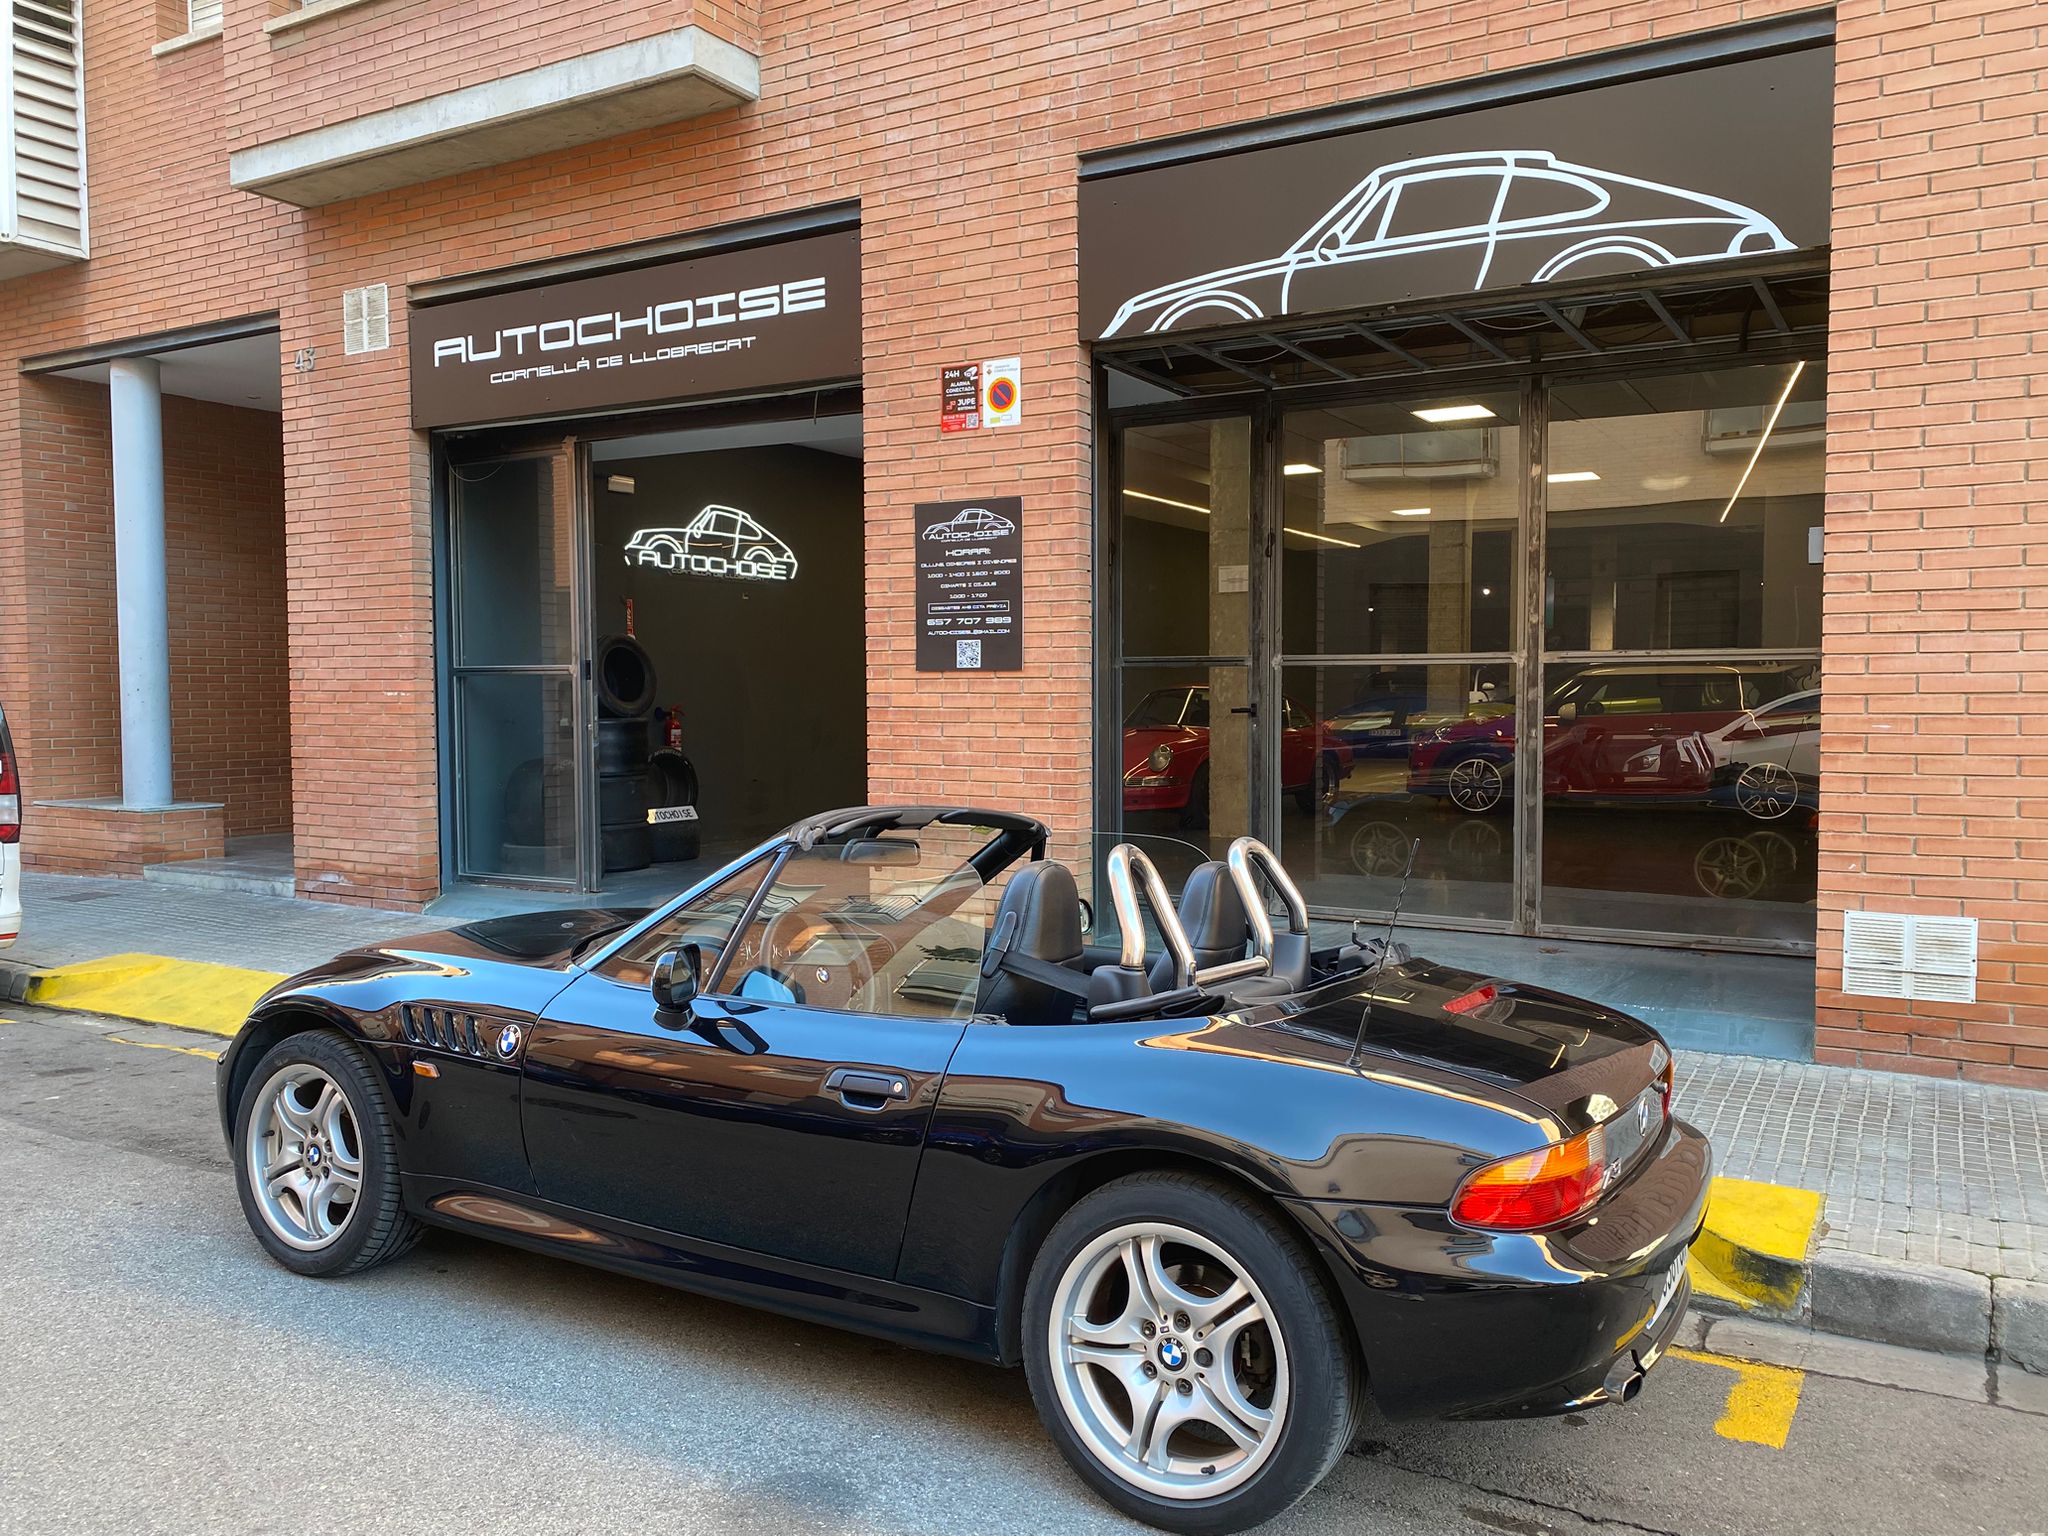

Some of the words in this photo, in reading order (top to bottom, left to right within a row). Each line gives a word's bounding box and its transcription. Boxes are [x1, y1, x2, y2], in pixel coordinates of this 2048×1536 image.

[433, 276, 826, 368] AUTOCHOISE
[596, 355, 623, 369] DE
[629, 335, 757, 364] LLOBREGAT
[294, 347, 315, 372] 43
[944, 370, 960, 379] 24H
[957, 398, 976, 406] JUPE
[928, 529, 1009, 540] AUTOCHOISE
[638, 550, 787, 581] AUTOCHOISE
[956, 617, 982, 625] 707
[654, 808, 694, 821] TOCHOISE
